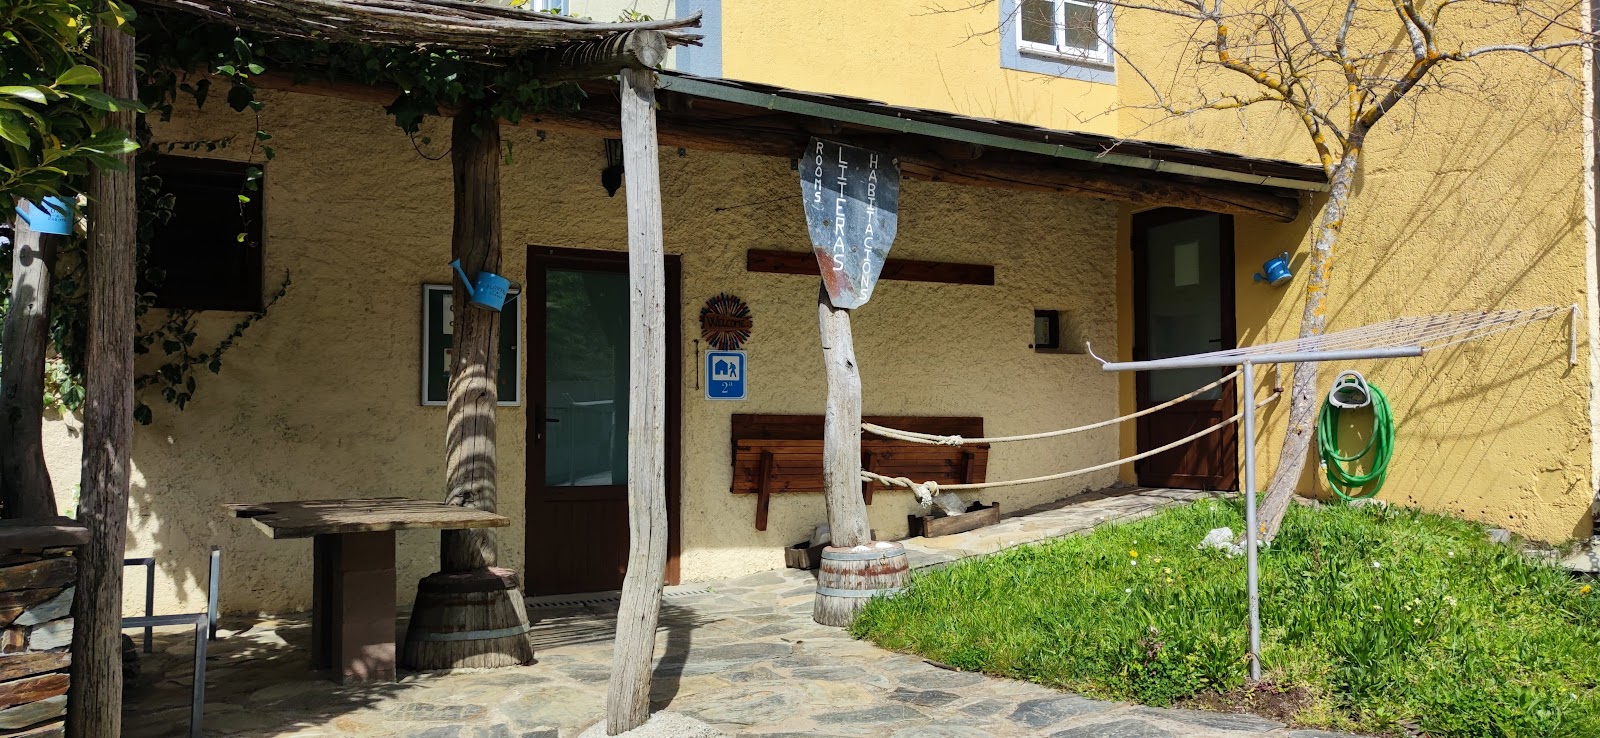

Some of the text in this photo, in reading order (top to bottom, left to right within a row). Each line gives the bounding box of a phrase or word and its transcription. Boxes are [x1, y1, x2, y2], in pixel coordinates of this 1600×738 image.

[813, 141, 824, 203] ROOMS
[832, 146, 848, 271] LITERAS
[859, 153, 879, 301] HABITACIONS
